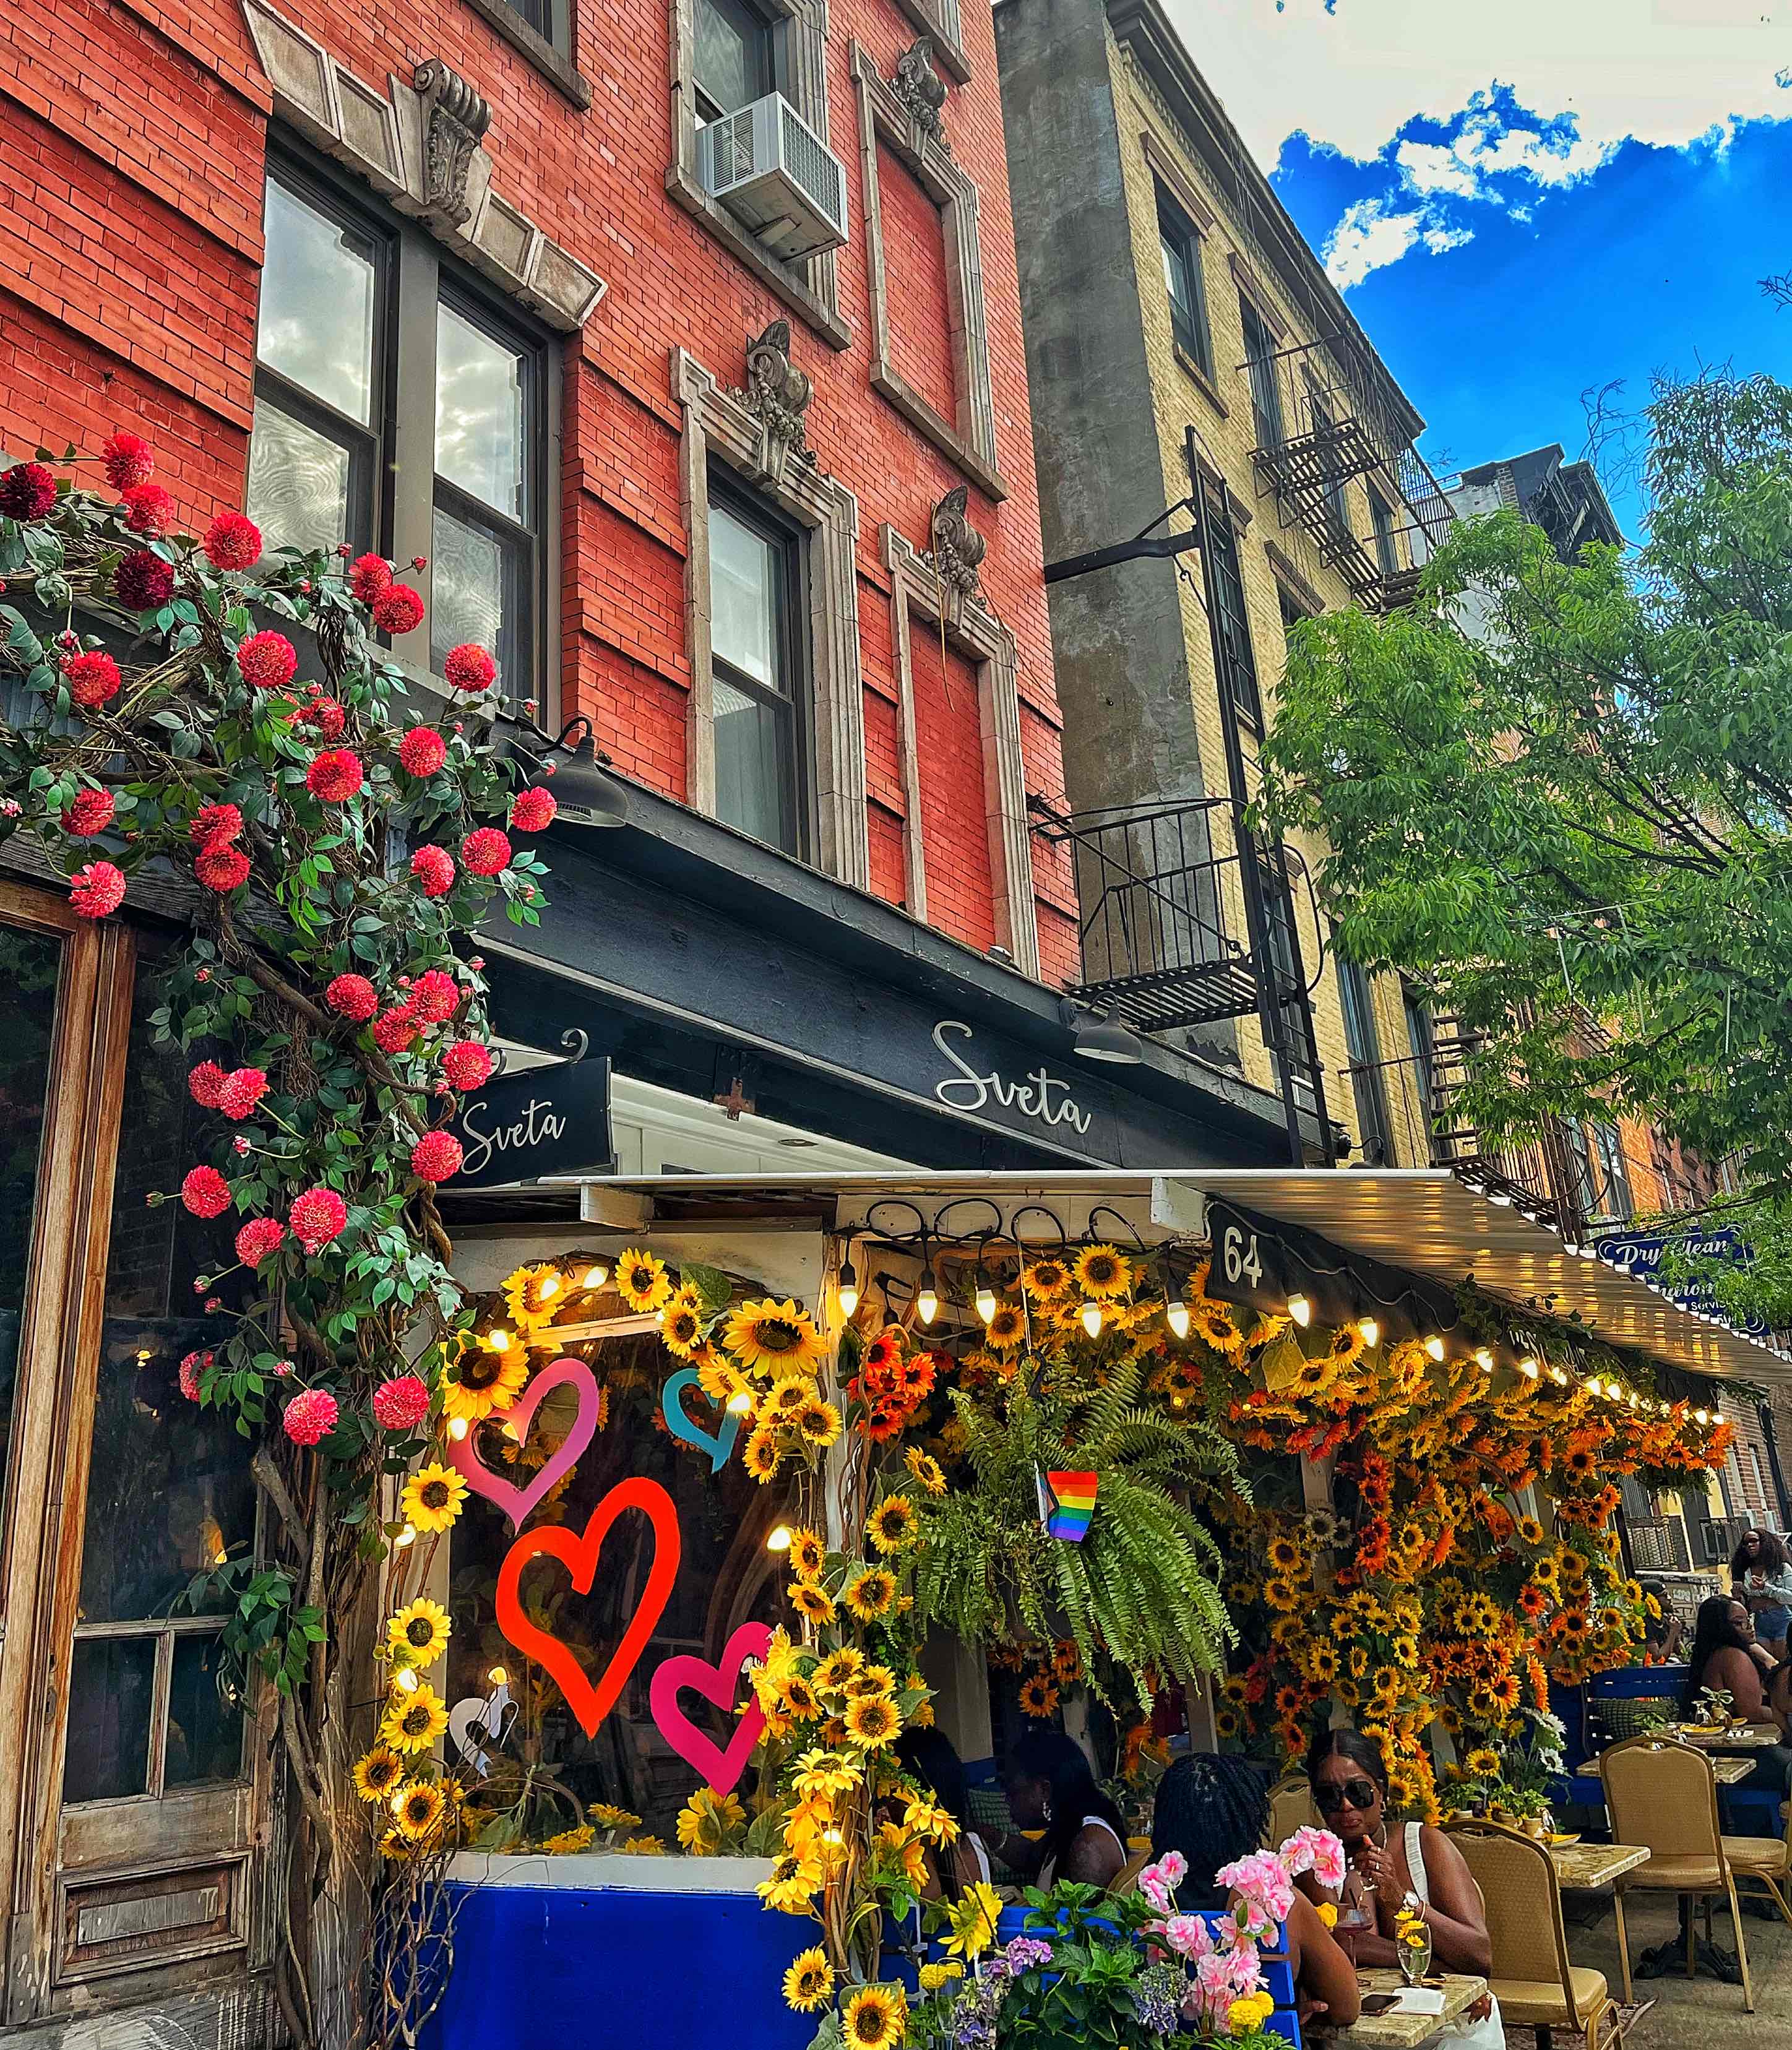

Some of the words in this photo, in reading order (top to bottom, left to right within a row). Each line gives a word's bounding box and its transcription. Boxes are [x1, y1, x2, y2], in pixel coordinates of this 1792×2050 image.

[932, 1021, 1092, 1134] Sveta
[461, 1099, 566, 1174] Sveta
[1225, 1226, 1263, 1288] 64
[1616, 1246, 1664, 1265] Dry
[1682, 1240, 1728, 1255] lean
